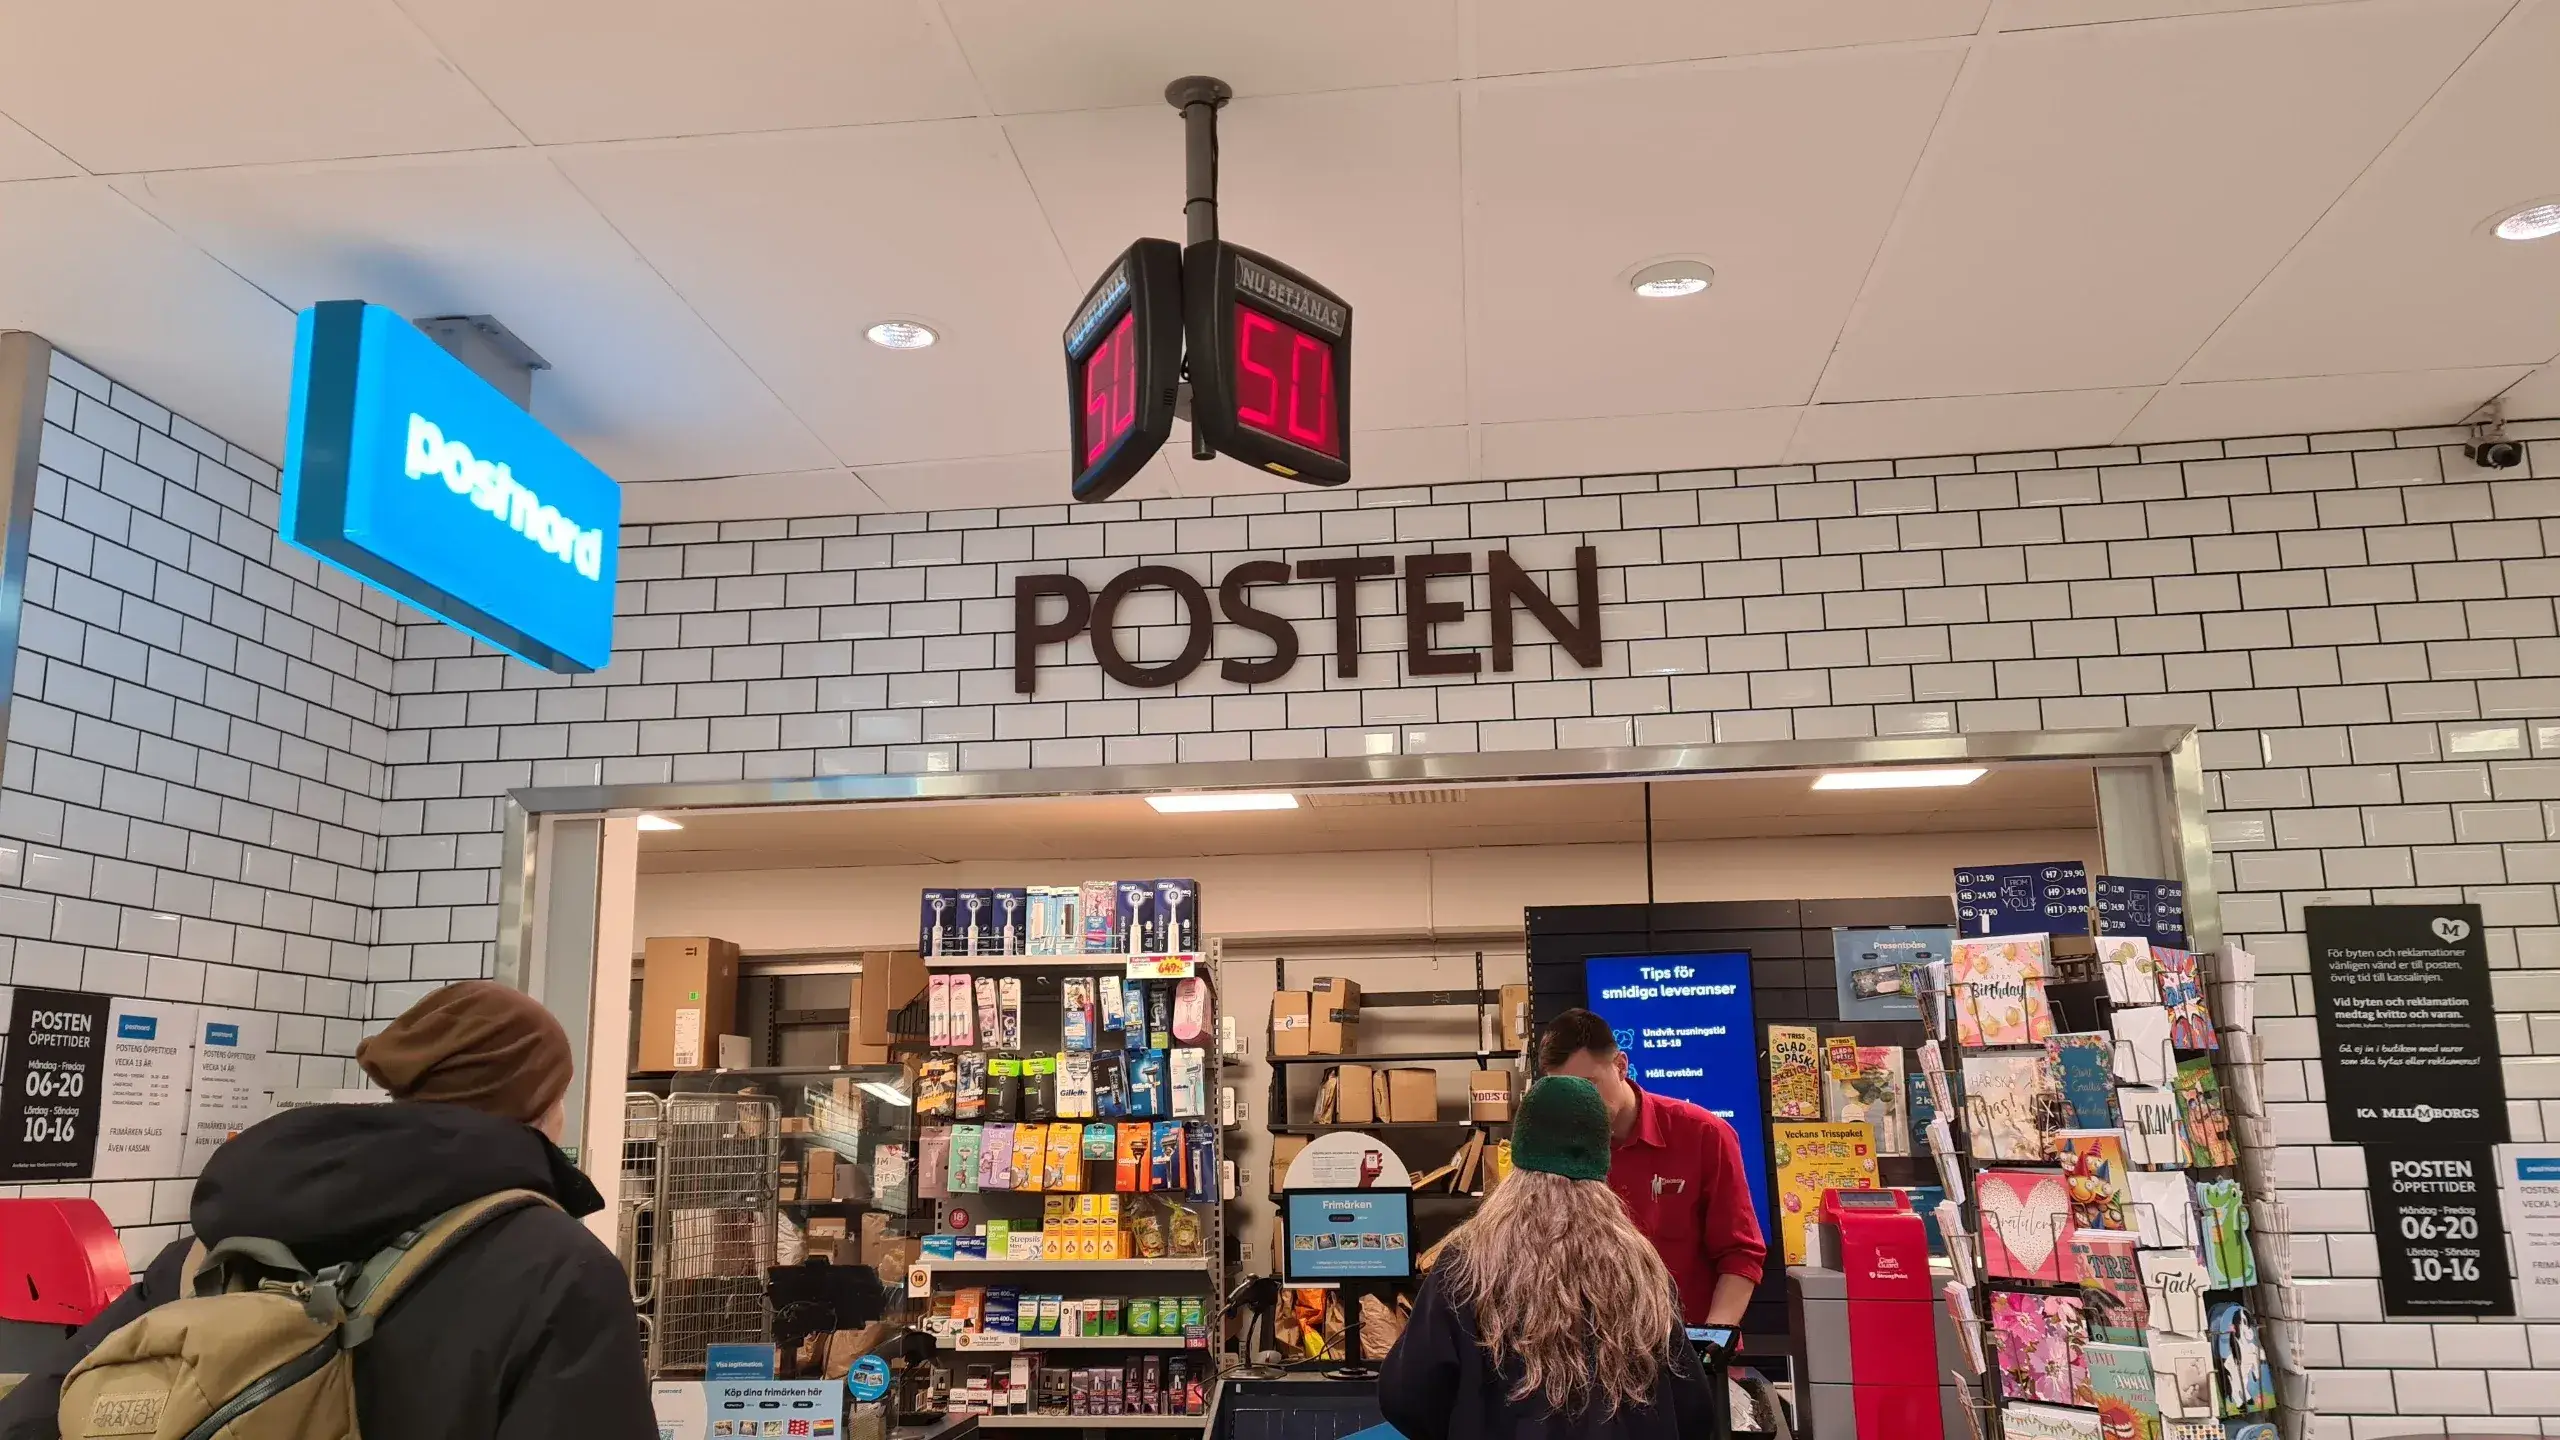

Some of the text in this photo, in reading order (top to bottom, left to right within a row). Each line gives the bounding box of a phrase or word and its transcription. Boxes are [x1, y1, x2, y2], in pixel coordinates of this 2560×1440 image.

[1242, 267, 1339, 329] NU BETJÄNAS
[1238, 311, 1332, 444] 50
[405, 412, 602, 582] postnord
[1015, 546, 1603, 694] POSTEN
[2063, 870, 2085, 878] 29,90
[2001, 886, 2016, 896] ME
[2001, 897, 2029, 909] YOU
[2441, 923, 2460, 937] M
[1873, 940, 1927, 950] Presentpåse
[2327, 948, 2467, 960] För byten och reklamationer
[2329, 960, 2462, 972] vänligen vänd er till posten,
[1640, 965, 1695, 982] Tips för
[2330, 973, 2443, 984] övrig tid till kassalinjen.
[1602, 984, 1736, 1000] smidiga leveranser
[1971, 982, 2025, 1003] Birthday
[2333, 997, 2470, 1009] Vid byten och reklamation
[2335, 1009, 2464, 1021] medtag kvitto och varan.
[30, 1010, 92, 1033] POSTEN
[124, 1023, 151, 1032] postnord
[1643, 1026, 1726, 1037] Undvik rusningstid
[28, 1031, 91, 1048] ÖPPETTIDER
[1643, 1039, 1682, 1049] kl. 15-18
[115, 1043, 177, 1055] POSTENS ÖPPETTIDER
[1776, 1041, 1807, 1054] GLAD
[2339, 1043, 2353, 1053] Gå
[2354, 1045, 2363, 1055] ej
[2365, 1045, 2374, 1053] in
[2381, 1044, 2417, 1053] butiken
[2418, 1044, 2439, 1053] med
[203, 1050, 256, 1061] POSTENS ÖPPETTIDER
[28, 1060, 86, 1073] Måndag Fredag
[115, 1058, 142, 1067] VECKA 13
[202, 1063, 219, 1071] VECKA
[2360, 1057, 2376, 1066] ska
[2377, 1057, 2404, 1068] bytas
[2405, 1057, 2427, 1066] eller
[1645, 1068, 1703, 1079] Håll avstånd
[25, 1071, 84, 1097] 06-20
[1970, 1075, 1991, 1088] HÄR
[1060, 1089, 1088, 1097] Gillette
[23, 1106, 80, 1118] Lördag Söndag
[2356, 1106, 2480, 1121] ICA MALMBORGS
[2136, 1104, 2174, 1135] KRAM
[23, 1117, 75, 1143] 10-16
[109, 1126, 162, 1137] FRIMÄRKEN SÄLJES
[197, 1121, 244, 1131] FRIMÄRKEN SÄLJES
[195, 1136, 209, 1145] ÄVEN
[1785, 1129, 1863, 1140] Veckans Trisspaket
[107, 1143, 123, 1153] ÄVEN
[2390, 1160, 2473, 1179] POSTEN
[2392, 1180, 2477, 1194] ÖPPETTIDER
[2520, 1187, 2559, 1195] POSTENS
[1322, 1201, 1373, 1210] Frimärken
[2522, 1200, 2551, 1208] VECKA
[2399, 1206, 2476, 1217] Måndag Fredag
[2401, 1216, 2479, 1240] 06-20
[1009, 1236, 1041, 1245] Strepsils
[2406, 1247, 2480, 1258] Lördag Söndag
[2088, 1254, 2136, 1279] TRE
[2412, 1258, 2480, 1282] 10-16
[914, 1274, 924, 1283] 18
[2155, 1270, 2198, 1294] Tack
[2535, 1277, 2560, 1286] ÄVEN
[716, 1361, 728, 1369] Visa
[724, 1388, 823, 1399] Köp dina frimärken här
[95, 1398, 161, 1414] MYSTERY
[94, 1412, 157, 1427] RANCH
